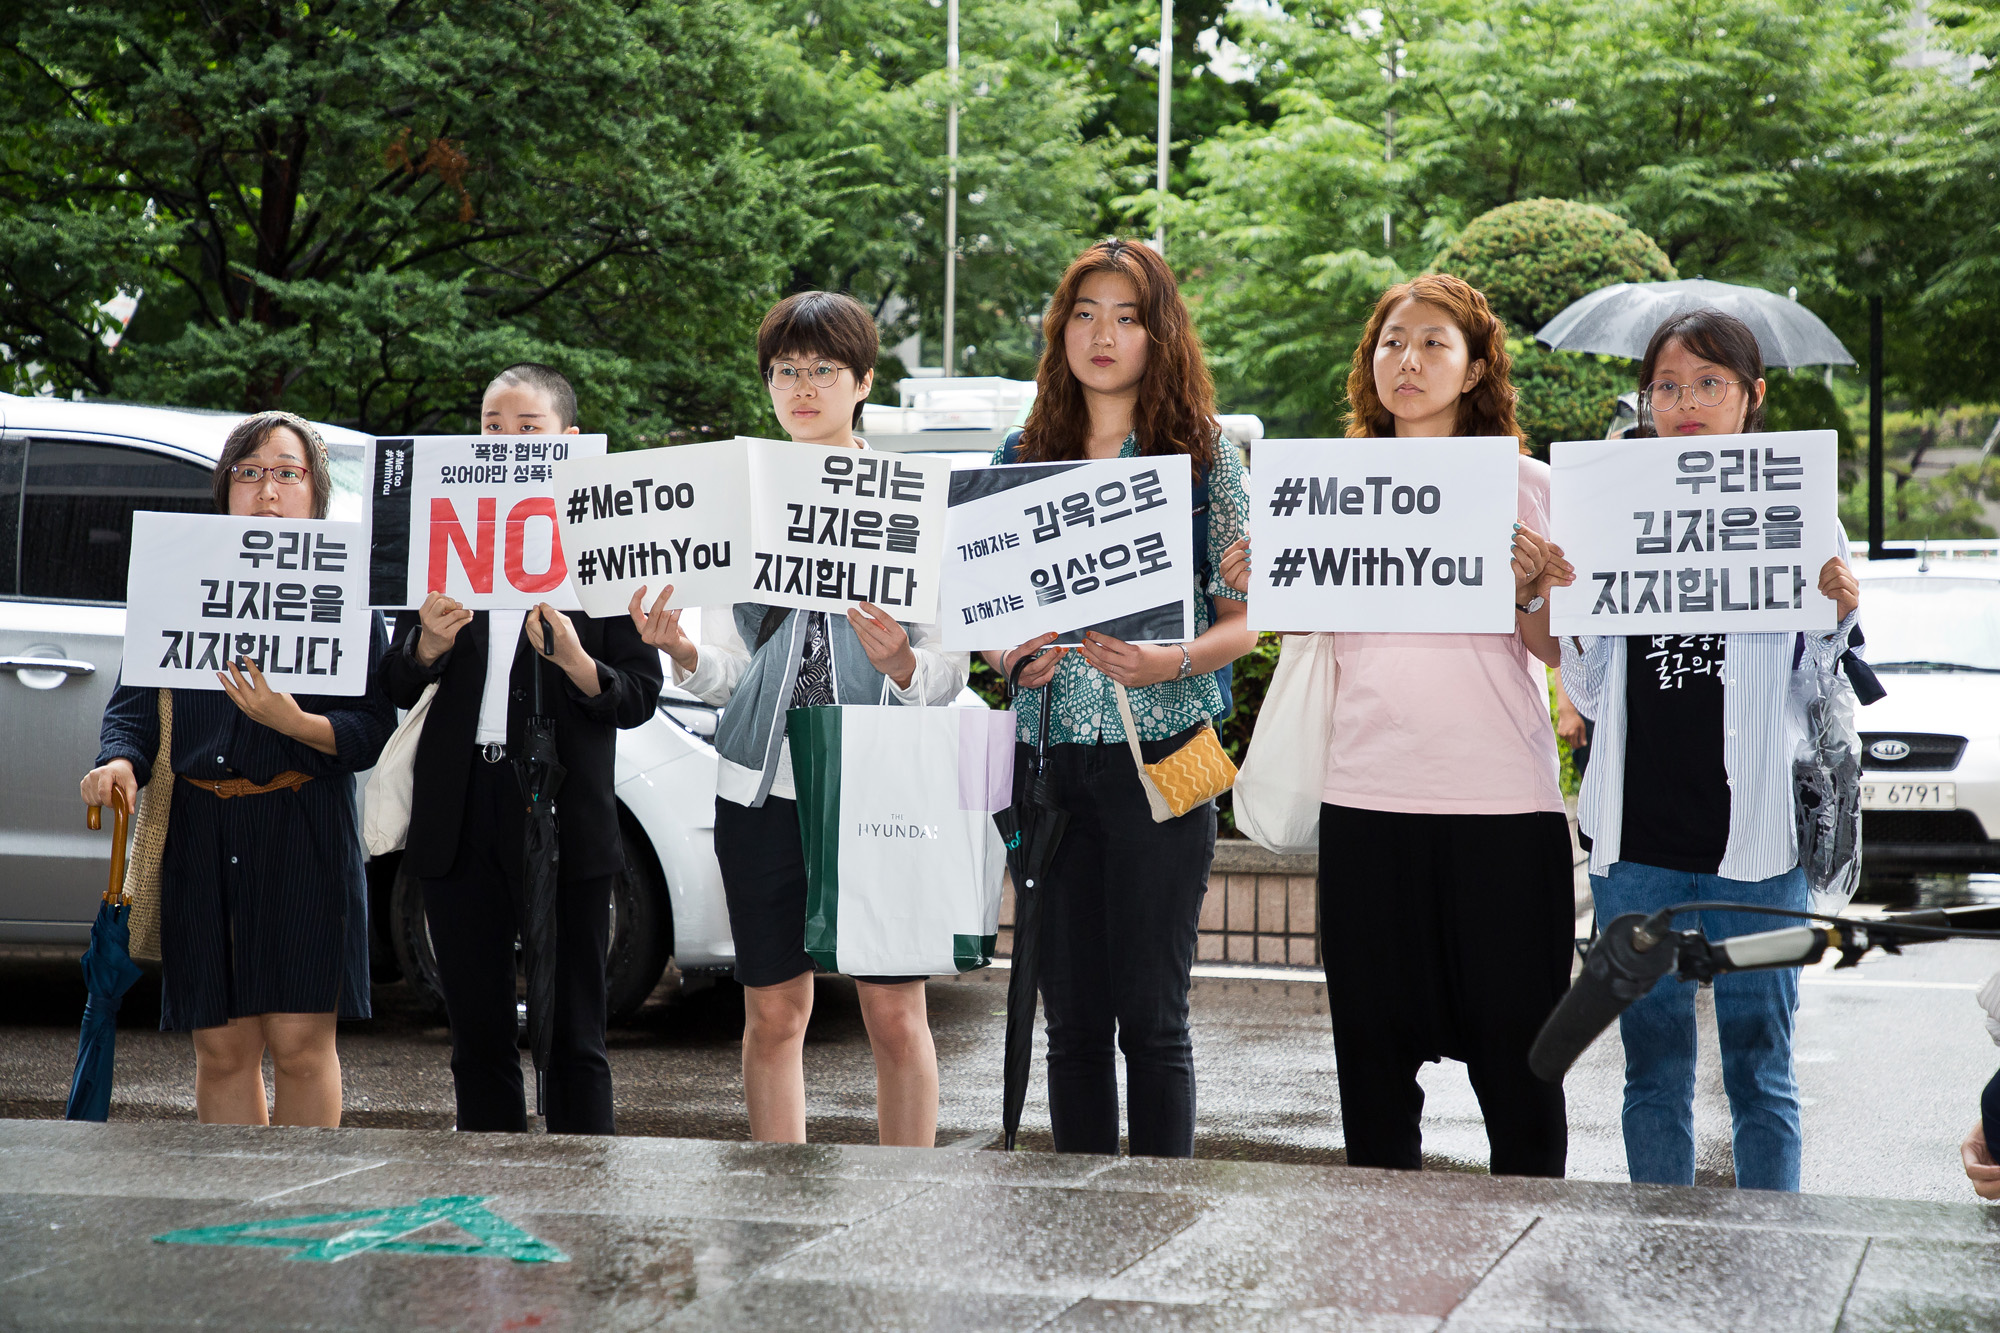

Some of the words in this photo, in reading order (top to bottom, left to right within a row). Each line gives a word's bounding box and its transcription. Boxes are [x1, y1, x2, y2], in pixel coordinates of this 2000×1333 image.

[382, 449, 395, 496] #WithYou
[393, 449, 405, 487] #MeToo
[441, 465, 507, 484] 있어야만
[821, 455, 925, 503] 우리는
[1675, 447, 1804, 495] 우리는
[566, 478, 695, 525] #MeToo
[956, 532, 1021, 562] 가해자는
[1023, 468, 1168, 544] 감옥으로
[1268, 476, 1441, 517] #MeToo
[239, 530, 348, 572] 우리는
[427, 496, 568, 594] NO
[786, 503, 921, 555] 김지은을
[1633, 505, 1804, 555] 김지은을
[577, 537, 732, 586] #WithYou
[753, 552, 918, 607] 지지합니다
[961, 594, 1025, 626] 피해자는
[1030, 531, 1173, 608] 일상으로
[1268, 547, 1484, 588] #WithYou
[200, 579, 345, 624] 김지은을
[1591, 564, 1807, 615] 지지합니다
[158, 630, 343, 676] 지지합니다
[1888, 784, 1940, 804] 6791
[858, 823, 938, 840] HYUNDAI
